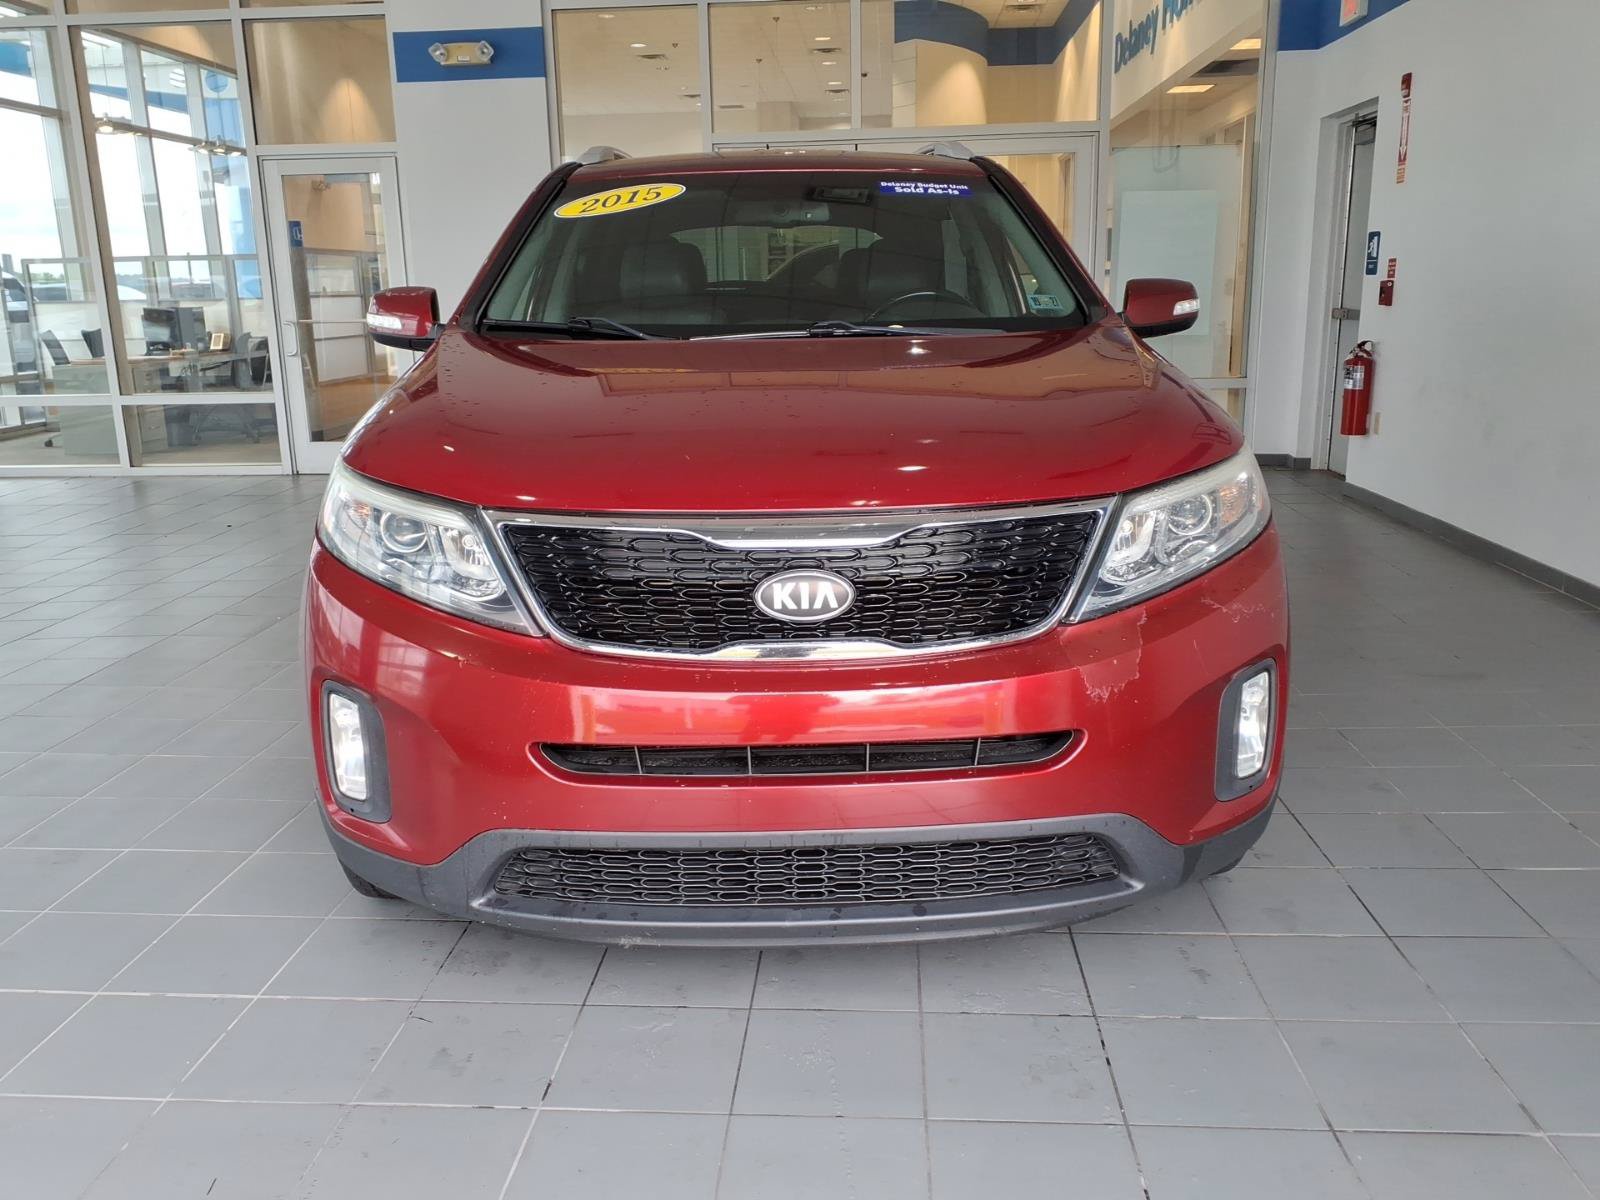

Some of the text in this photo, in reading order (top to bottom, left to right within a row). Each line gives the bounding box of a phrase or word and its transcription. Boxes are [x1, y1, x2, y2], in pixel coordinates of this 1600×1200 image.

[1114, 4, 1159, 74] Delaney
[880, 181, 916, 189] Delaney
[927, 187, 960, 195] As-Is
[579, 186, 663, 214] 2015
[772, 581, 839, 610] KIA
